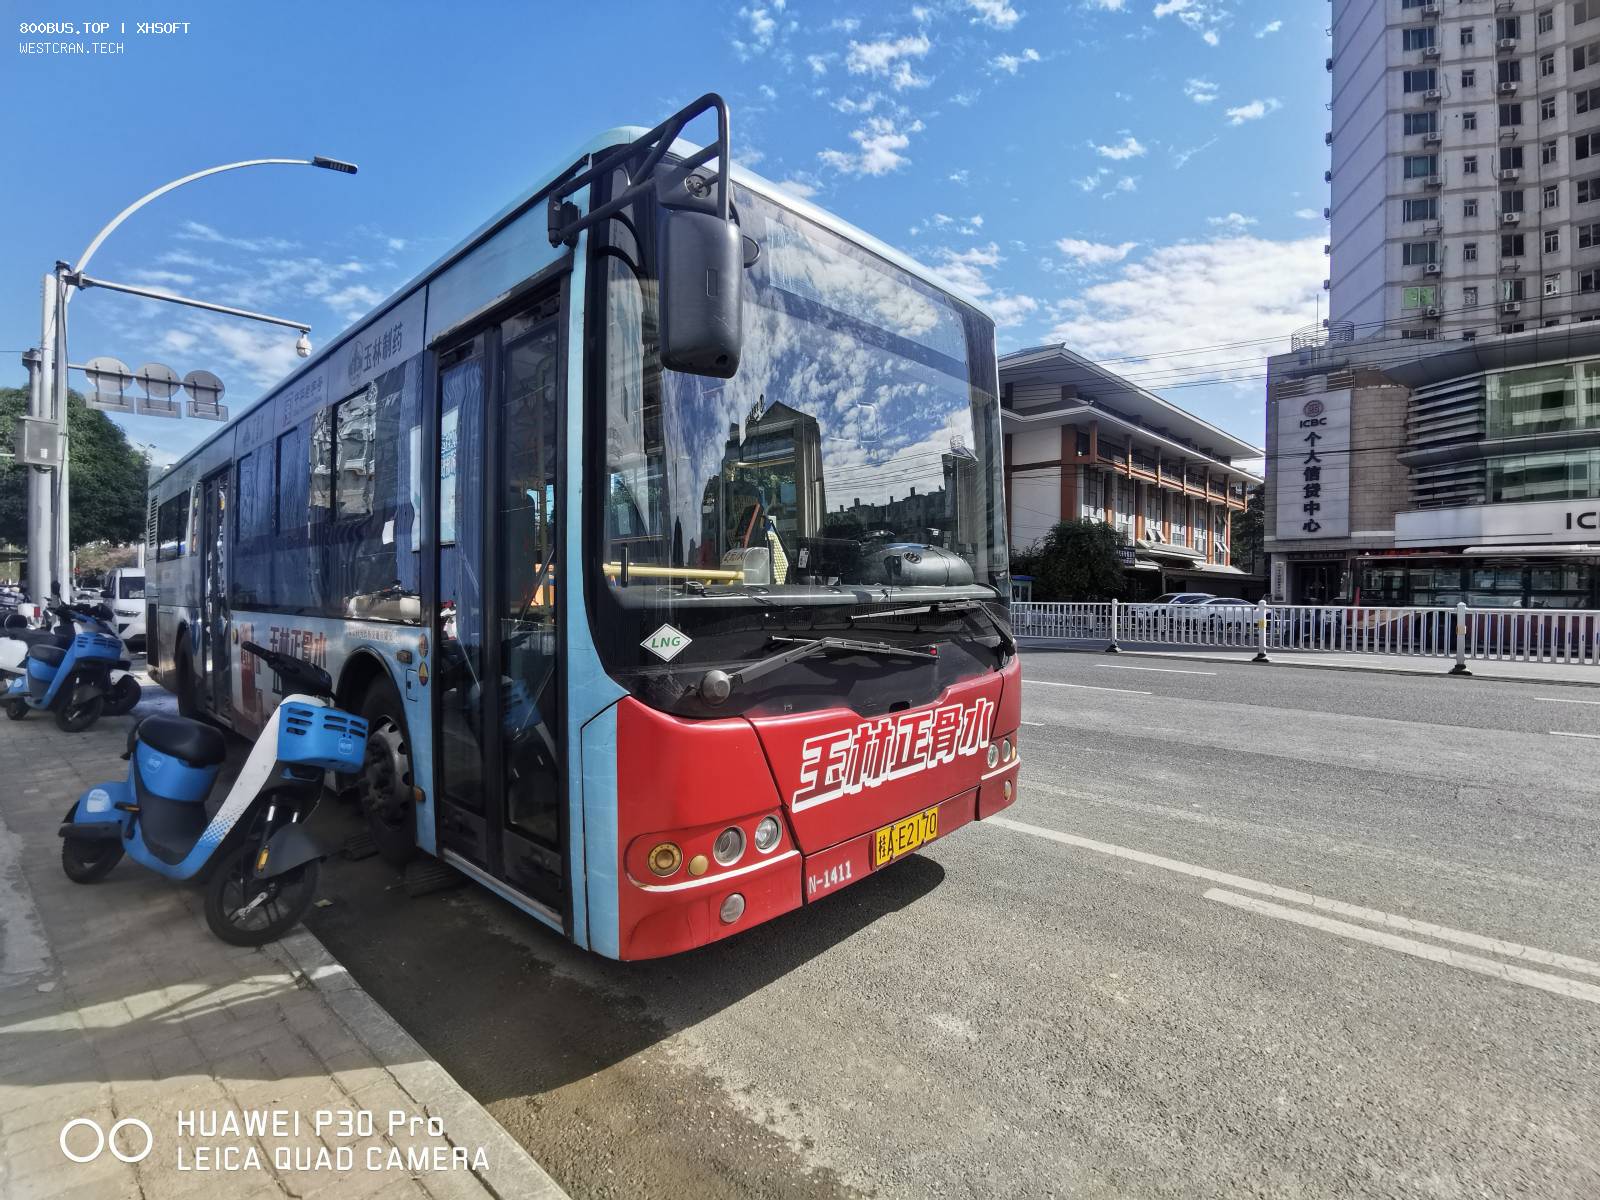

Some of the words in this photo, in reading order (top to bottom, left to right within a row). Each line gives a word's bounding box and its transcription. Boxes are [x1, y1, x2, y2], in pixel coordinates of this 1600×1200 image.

[363, 322, 403, 372] 玉林制药
[1299, 417, 1327, 428] ICBC
[1303, 431, 1321, 533] 个人信贷中心
[1566, 511, 1600, 530] IC
[651, 636, 681, 648] LNG
[792, 698, 994, 814] 玉林正骨水
[808, 861, 852, 893] N-1411
